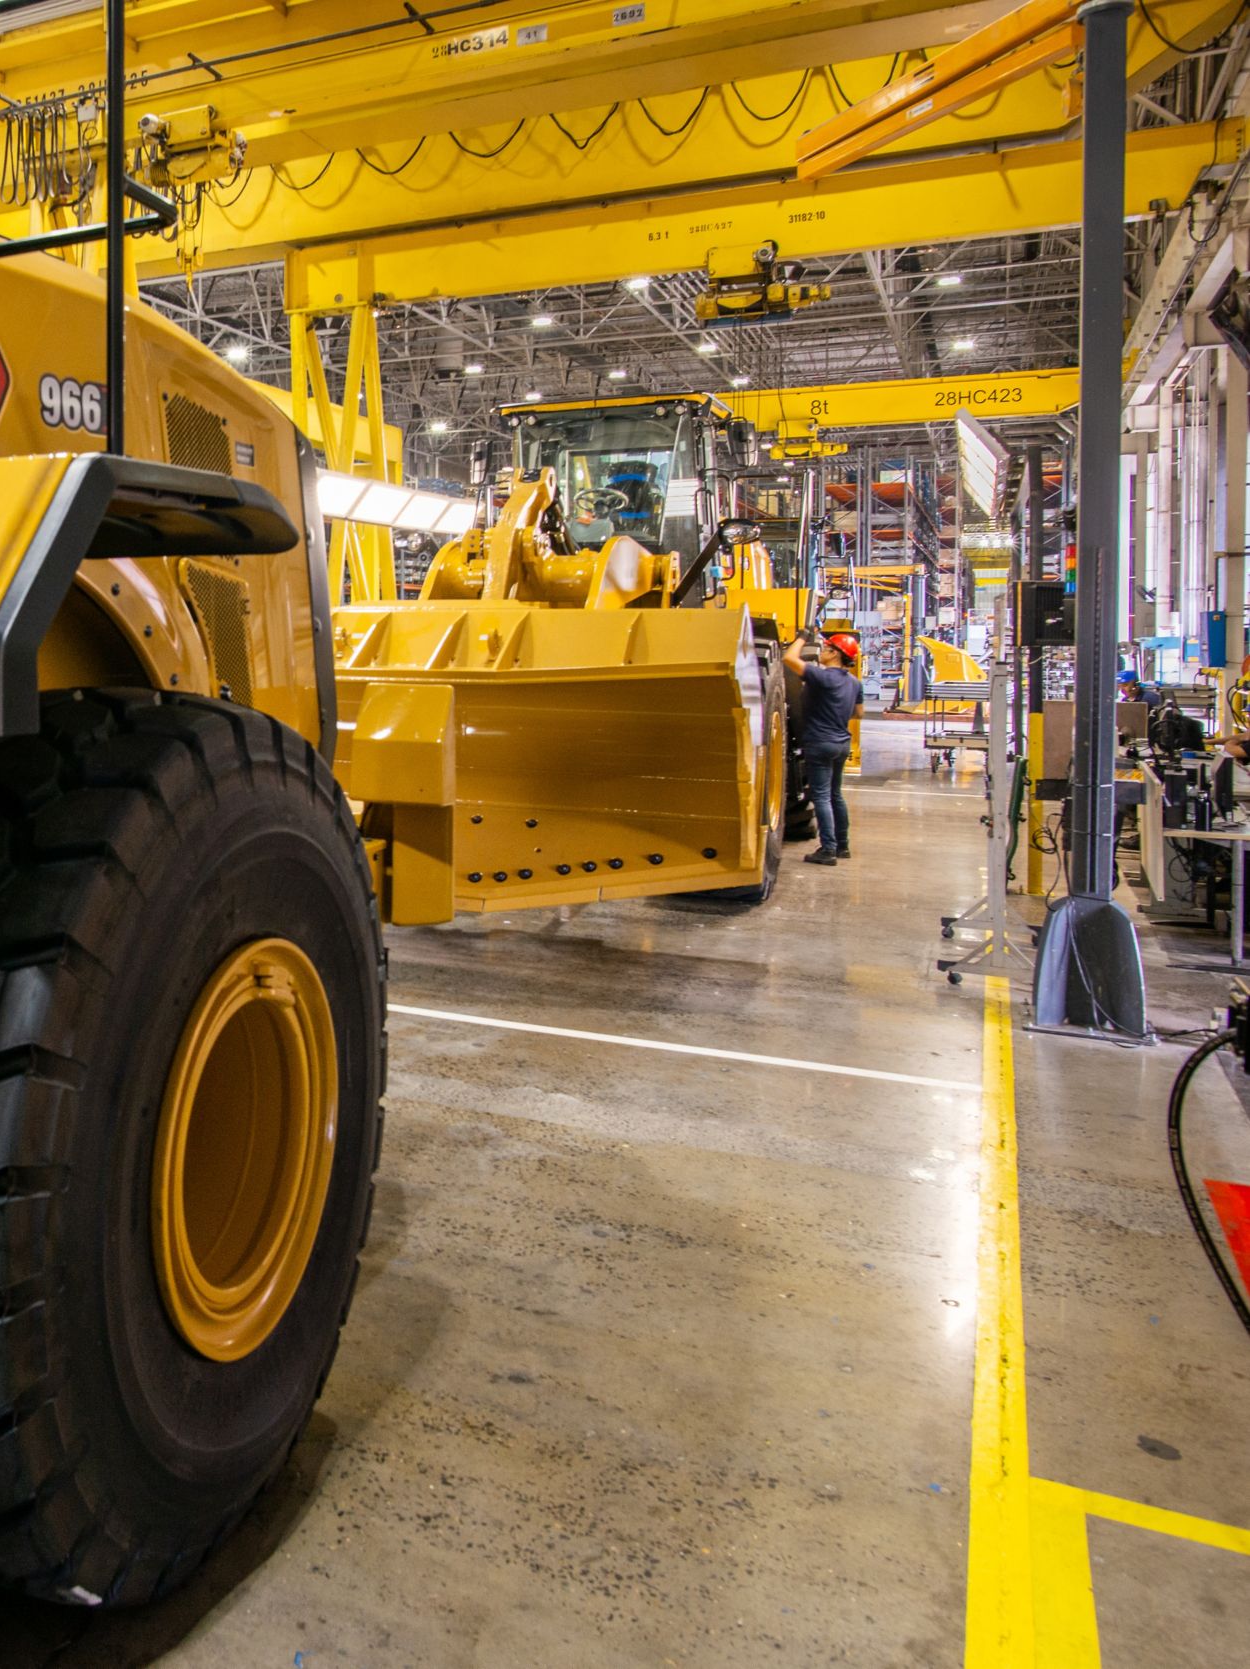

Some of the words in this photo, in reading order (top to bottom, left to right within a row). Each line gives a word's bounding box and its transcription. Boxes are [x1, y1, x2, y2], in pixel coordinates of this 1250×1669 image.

[432, 30, 509, 59] 28HC314
[40, 375, 101, 431] 966
[810, 399, 829, 416] 8t
[934, 387, 1023, 407] 28HC423
